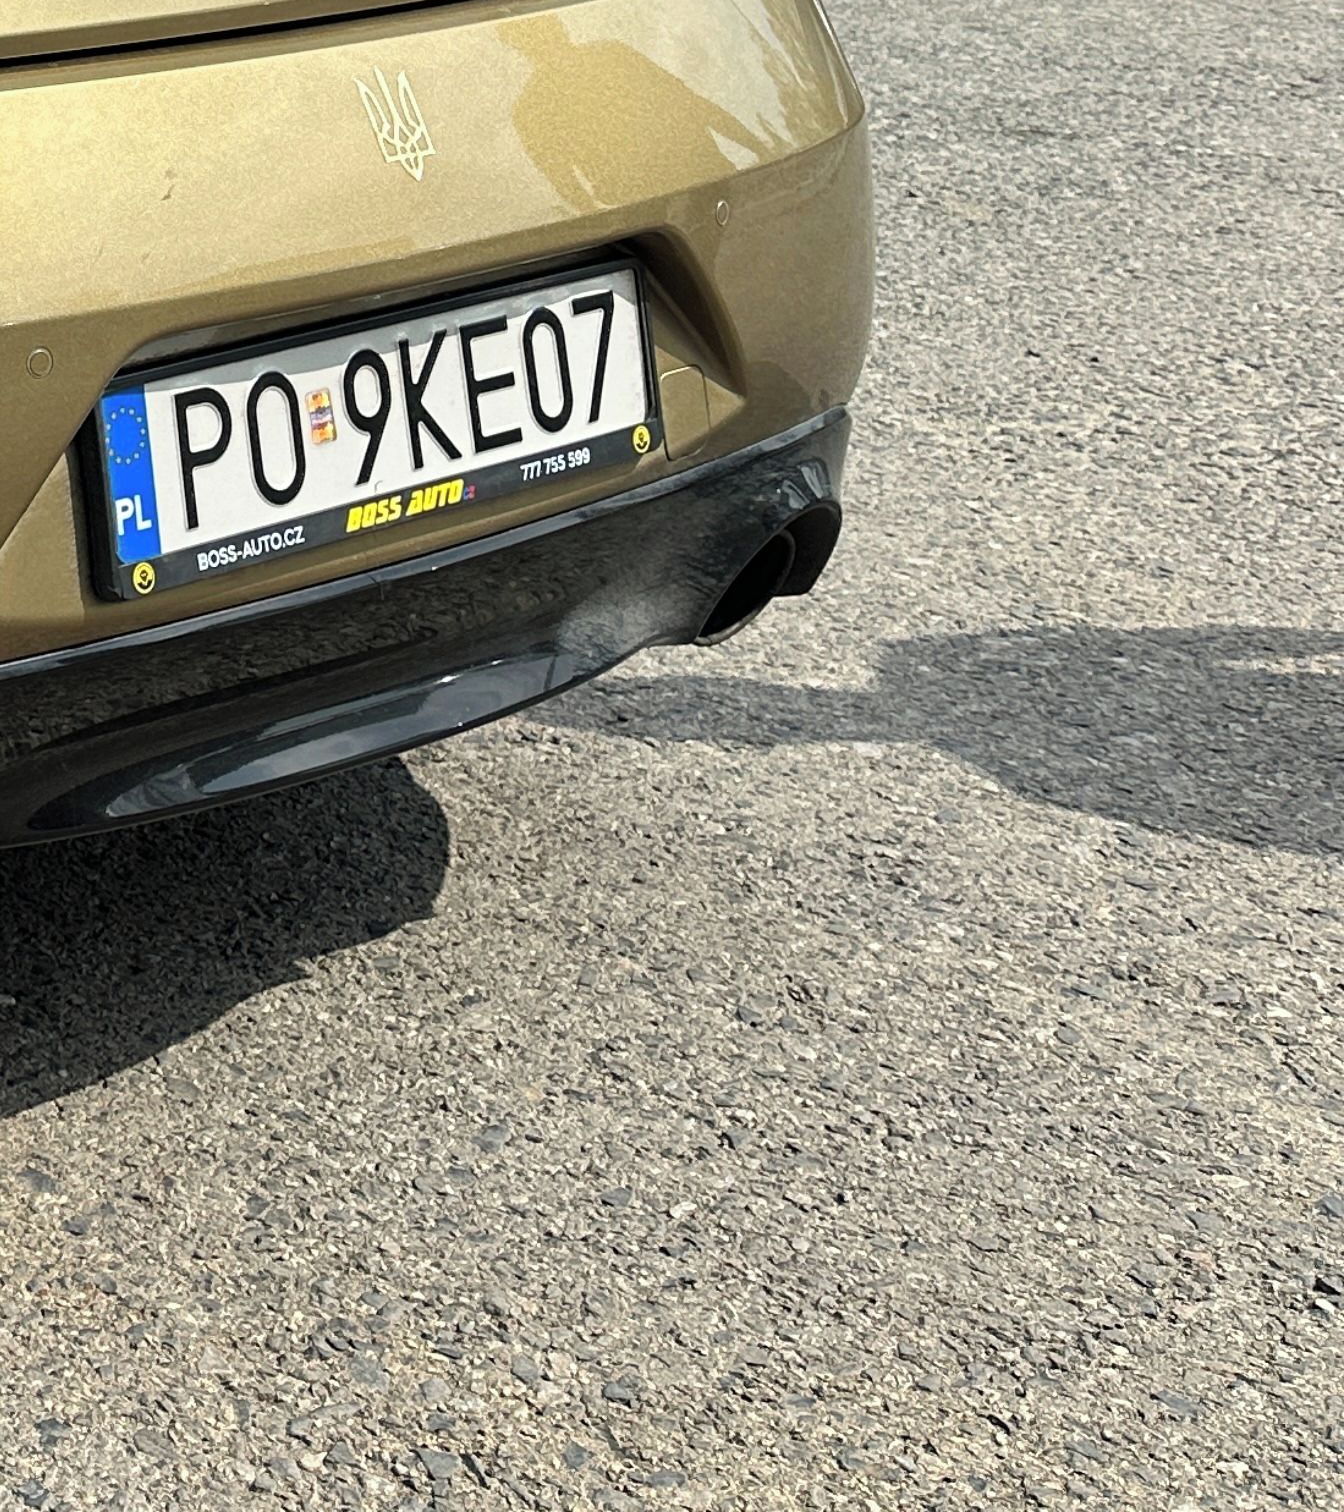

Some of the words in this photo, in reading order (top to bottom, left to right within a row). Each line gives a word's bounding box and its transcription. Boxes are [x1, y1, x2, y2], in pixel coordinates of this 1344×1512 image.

[174, 370, 306, 530] PO
[341, 290, 614, 486] 9KE07
[520, 460, 542, 481] 777
[543, 454, 566, 475] 755
[567, 447, 591, 468] 599
[115, 494, 153, 536] PL
[346, 495, 402, 533] BOSS
[405, 479, 464, 517] AUTO
[197, 525, 306, 571] BOSS-AUTO.CZ
